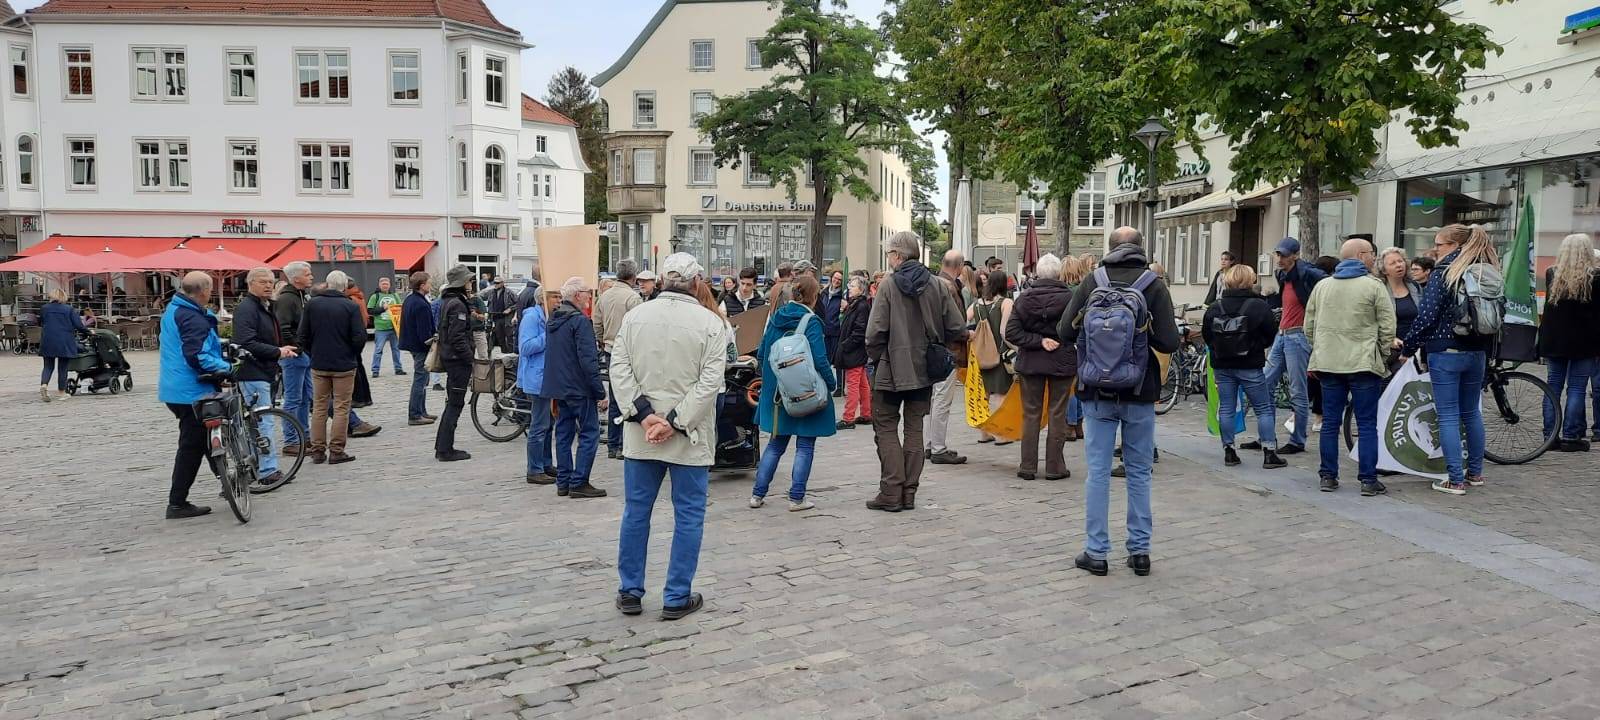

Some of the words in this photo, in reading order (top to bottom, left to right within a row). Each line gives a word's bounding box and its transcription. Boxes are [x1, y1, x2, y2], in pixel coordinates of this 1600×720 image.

[725, 201, 784, 211] Deutsche
[790, 201, 816, 211] Ban
[222, 220, 266, 234] extrablatt
